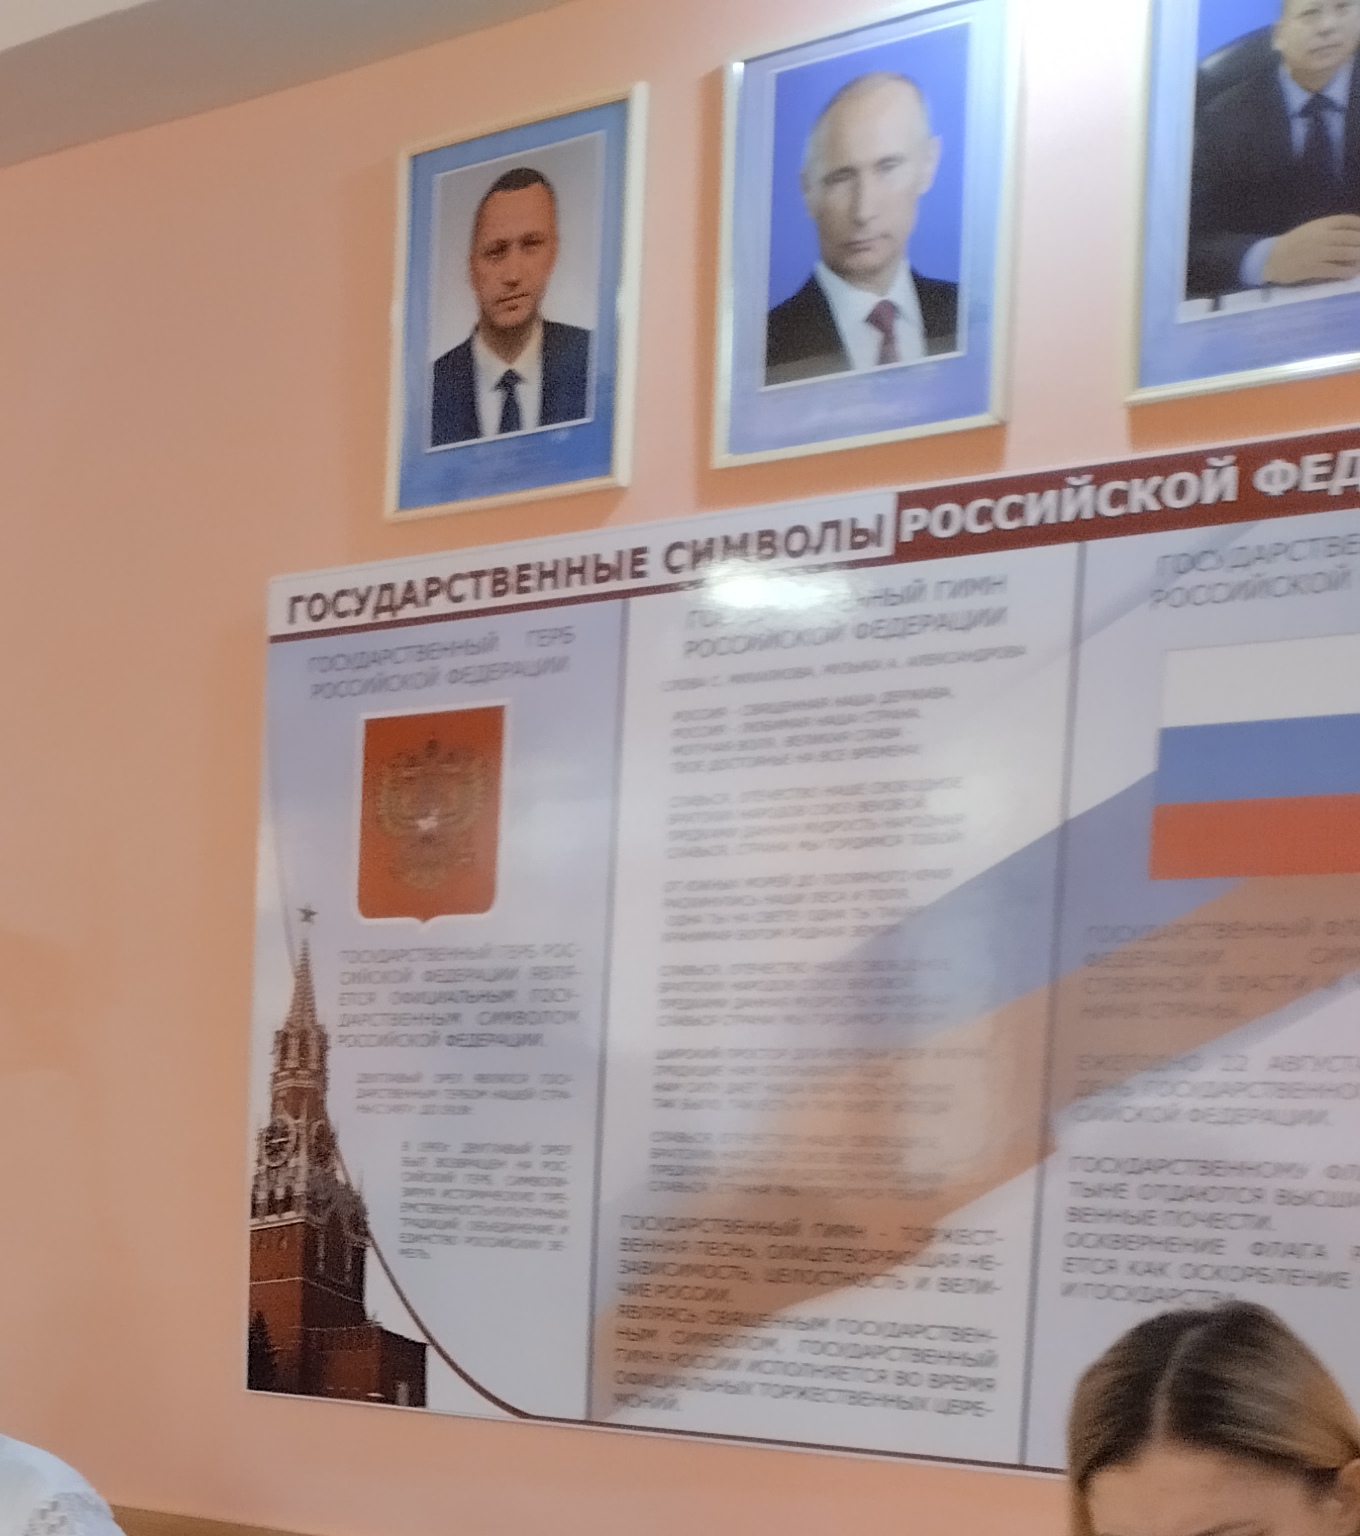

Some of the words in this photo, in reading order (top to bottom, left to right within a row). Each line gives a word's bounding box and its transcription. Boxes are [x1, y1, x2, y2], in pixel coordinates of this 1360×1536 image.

[286, 546, 649, 624] ГОСУДАРСТВЕННЫЕ
[663, 511, 885, 576] СИМВОЛЫ
[898, 456, 1239, 542] РОССИЙСКОЙ
[1149, 563, 1352, 611] РОССИЙСКОЙ
[852, 606, 1008, 641] ФЕДЕРАЦИИ
[307, 631, 500, 673] ГОСУДАРСТВЕННЫЙ
[309, 666, 442, 699] РОССИЙСКОЙ
[446, 655, 570, 685] ФЕДЕРАЦИИ
